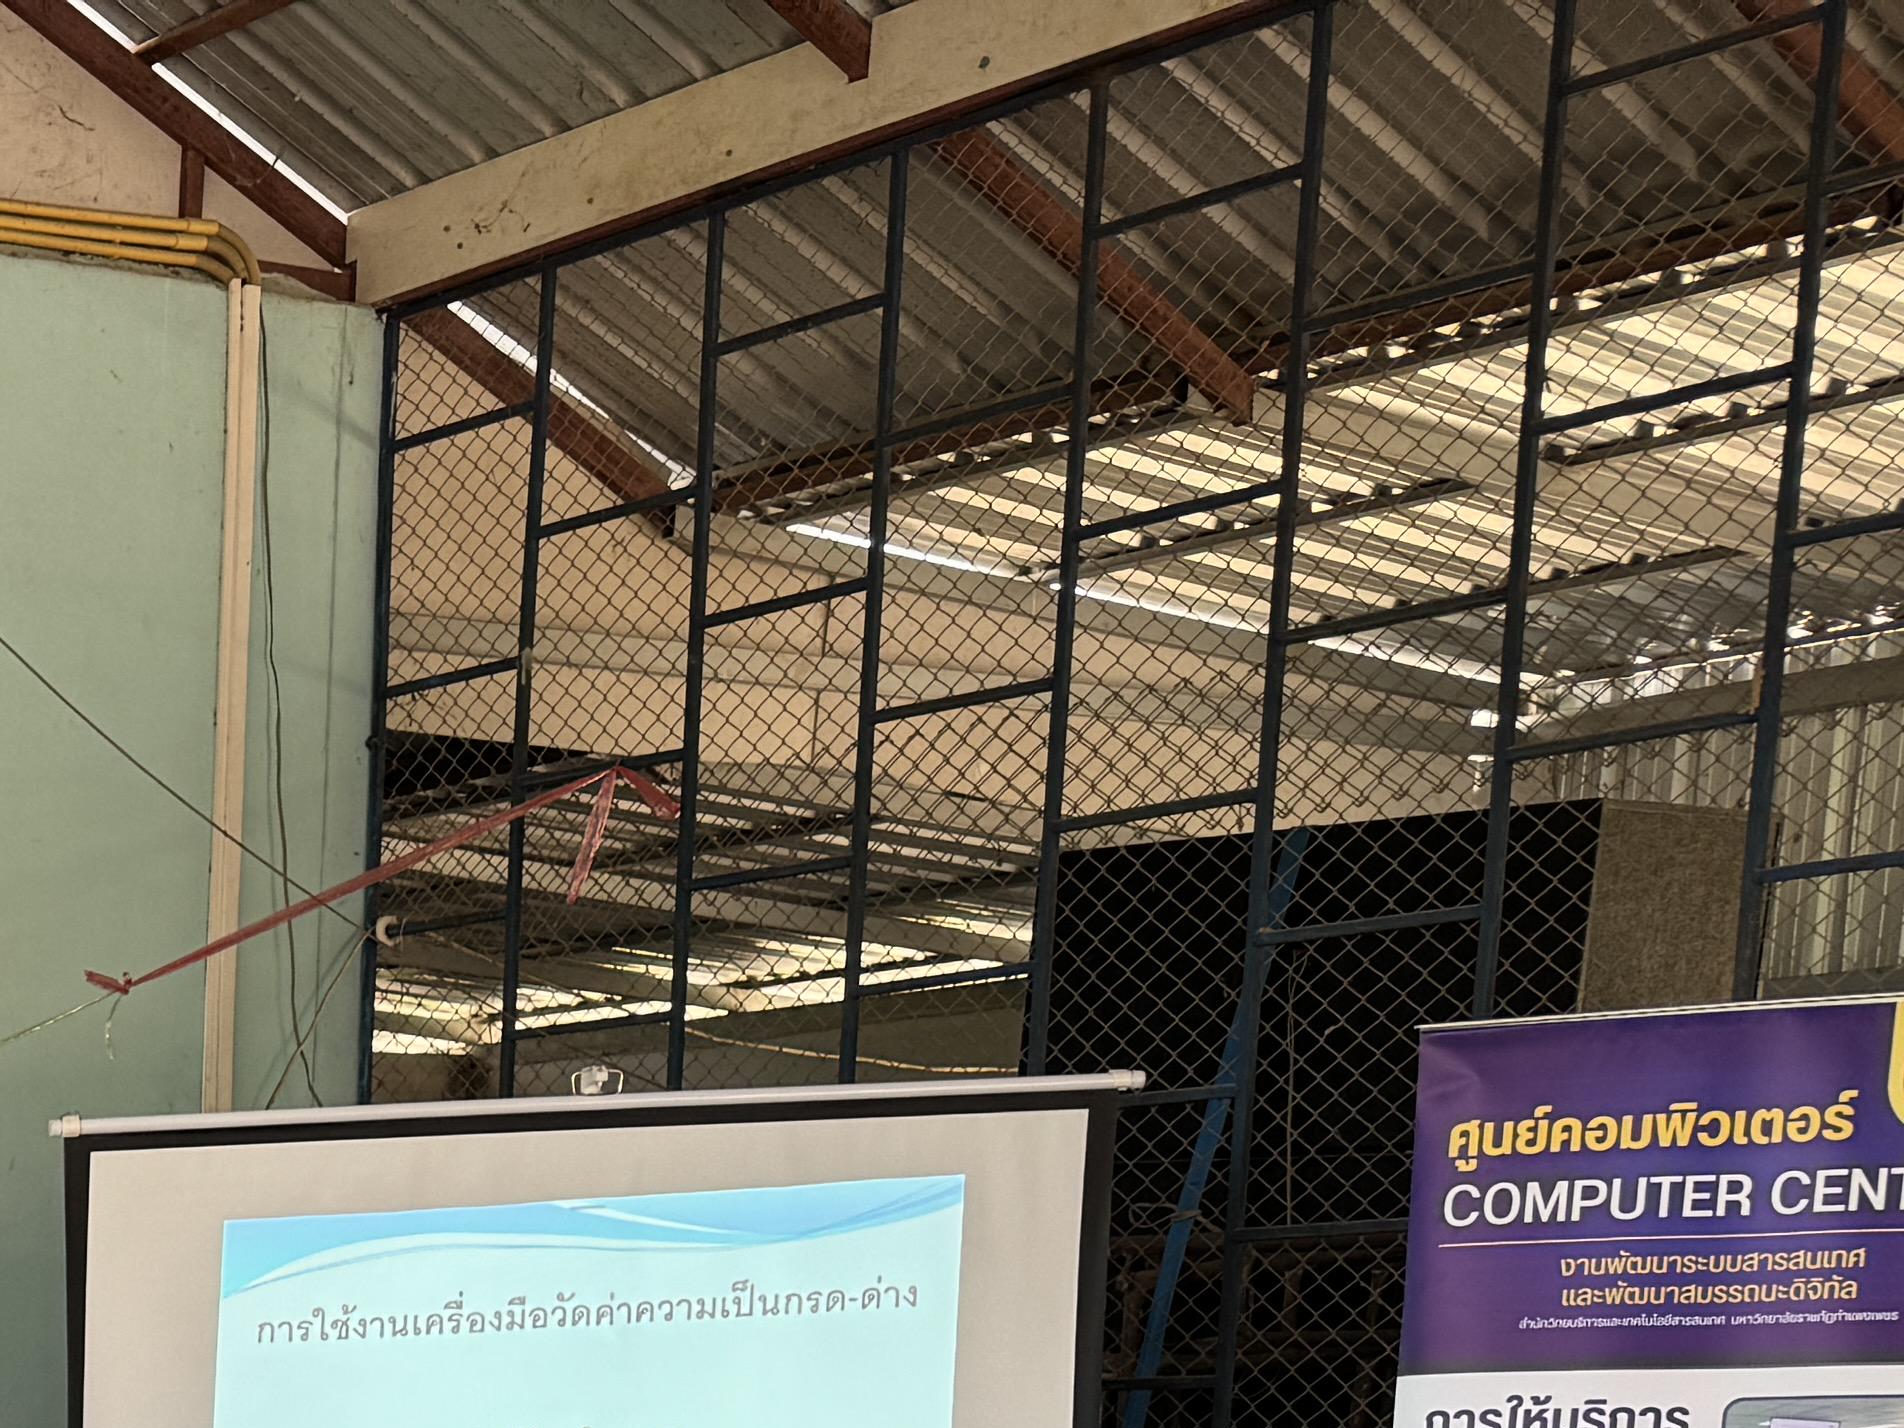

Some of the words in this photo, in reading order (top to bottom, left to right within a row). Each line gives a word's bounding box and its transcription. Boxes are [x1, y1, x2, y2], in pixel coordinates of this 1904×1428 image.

[1448, 1089, 1859, 1173] ศูนย์คอมพิวเตอร์
[1443, 1173, 1752, 1229] COMPUTER
[1560, 1247, 1866, 1278] งานพัฒนาระบบสารสนเทศ
[256, 1275, 919, 1346] การใช้งานเครื่องมือวัดค่าความเป็นกรด-ด่าง
[1561, 1275, 1857, 1308] และพัฒนาสมรรถนะดิจิทัล
